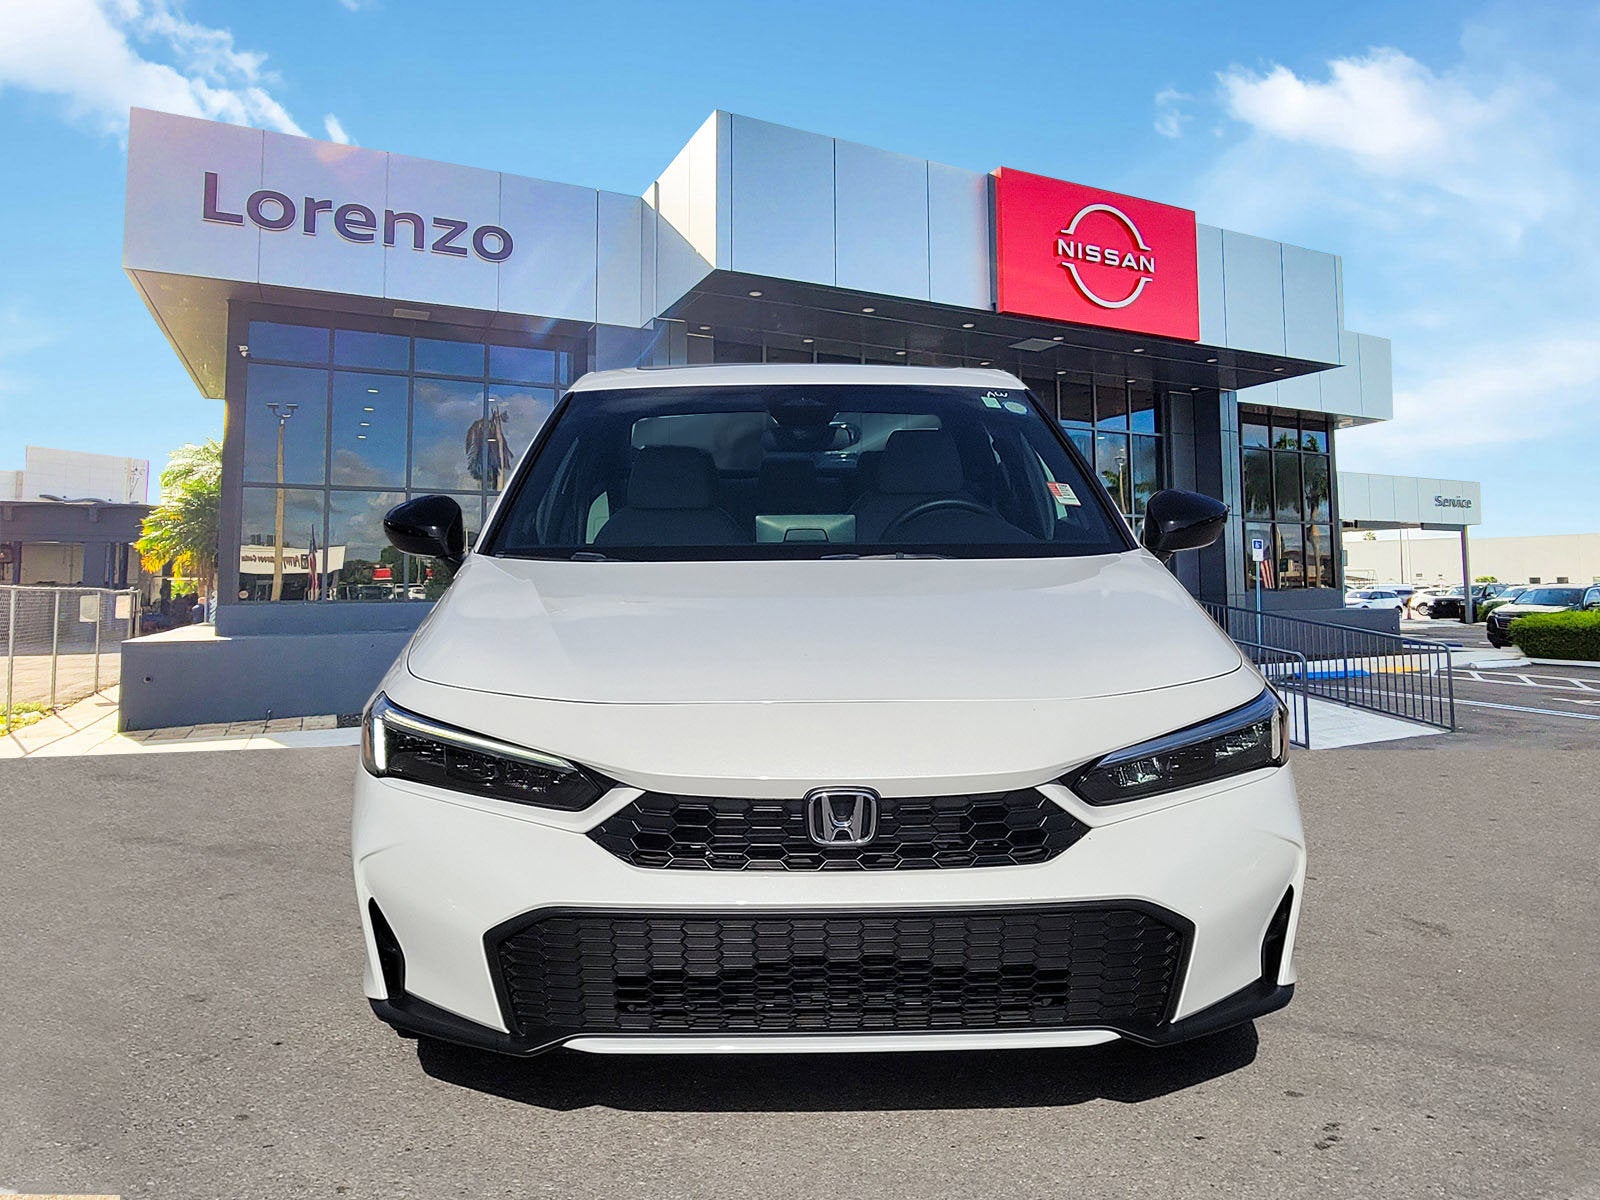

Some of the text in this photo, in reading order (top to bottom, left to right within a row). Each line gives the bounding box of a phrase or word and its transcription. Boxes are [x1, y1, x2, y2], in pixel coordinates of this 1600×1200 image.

[202, 171, 515, 263] Lorenzo
[1057, 238, 1155, 273] NISSAN
[1434, 495, 1472, 509] Service
